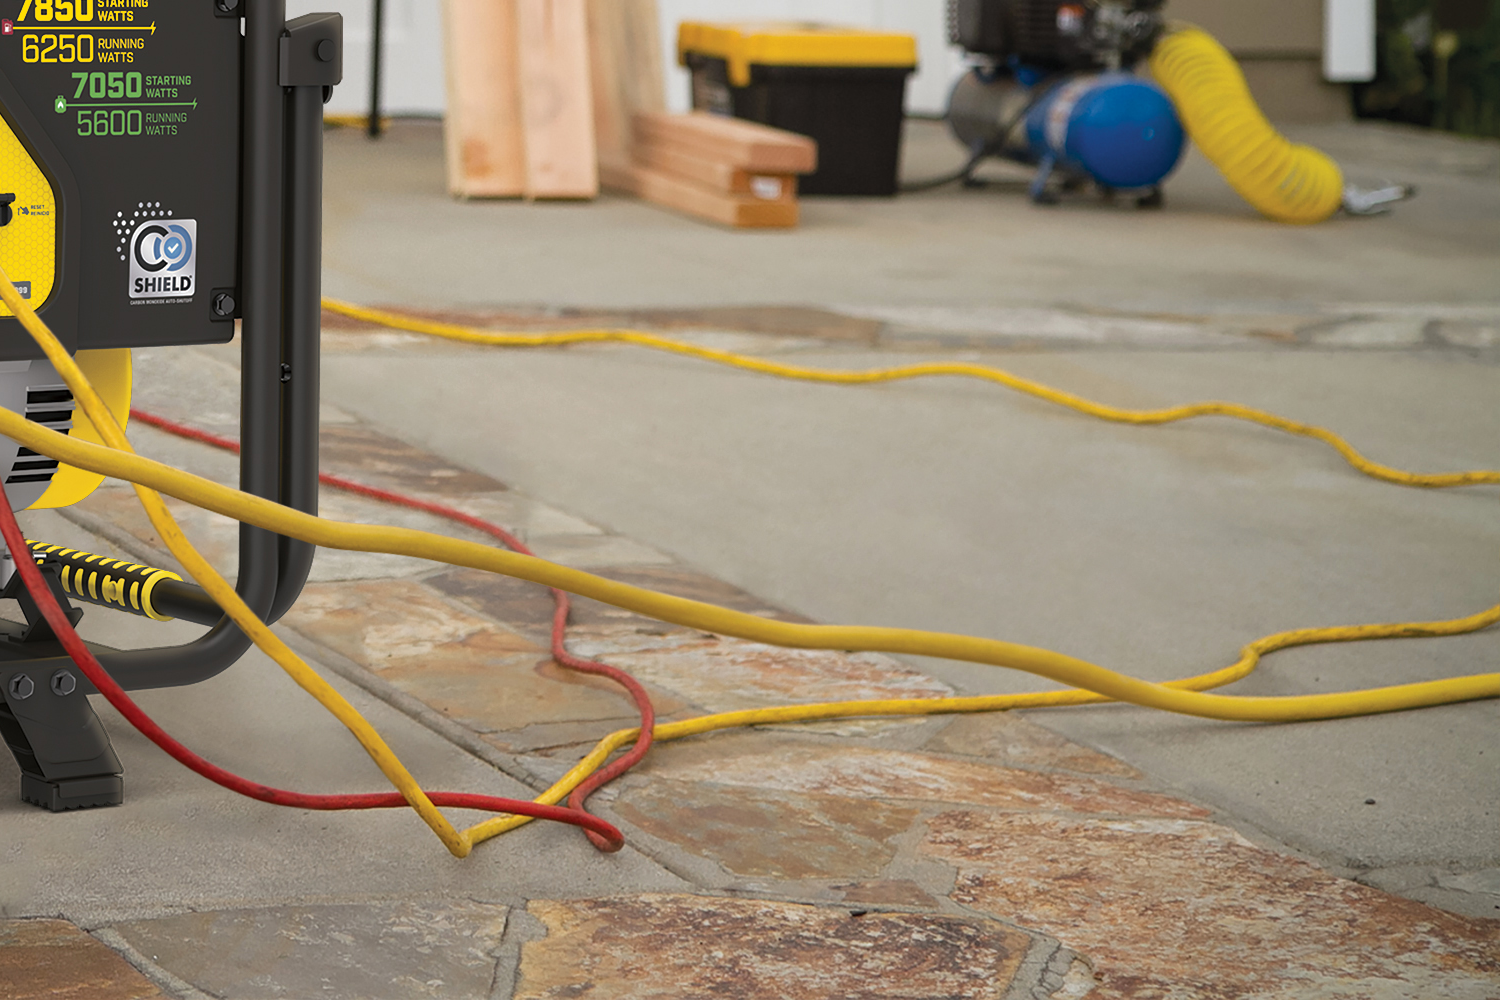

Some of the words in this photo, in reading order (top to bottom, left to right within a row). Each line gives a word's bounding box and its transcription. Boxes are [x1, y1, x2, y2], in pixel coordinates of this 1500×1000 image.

[97, 10, 134, 22] WATTS
[22, 34, 94, 63] 6250
[98, 38, 145, 49] RUNNING
[97, 52, 134, 63] WATTS
[71, 71, 142, 99] 7050
[145, 75, 192, 86] STARTING
[145, 88, 178, 98] WATTS
[77, 109, 142, 136] 5600
[145, 112, 187, 123] RUNNING
[145, 125, 178, 136] WATTS
[134, 276, 192, 293] SHIELD
